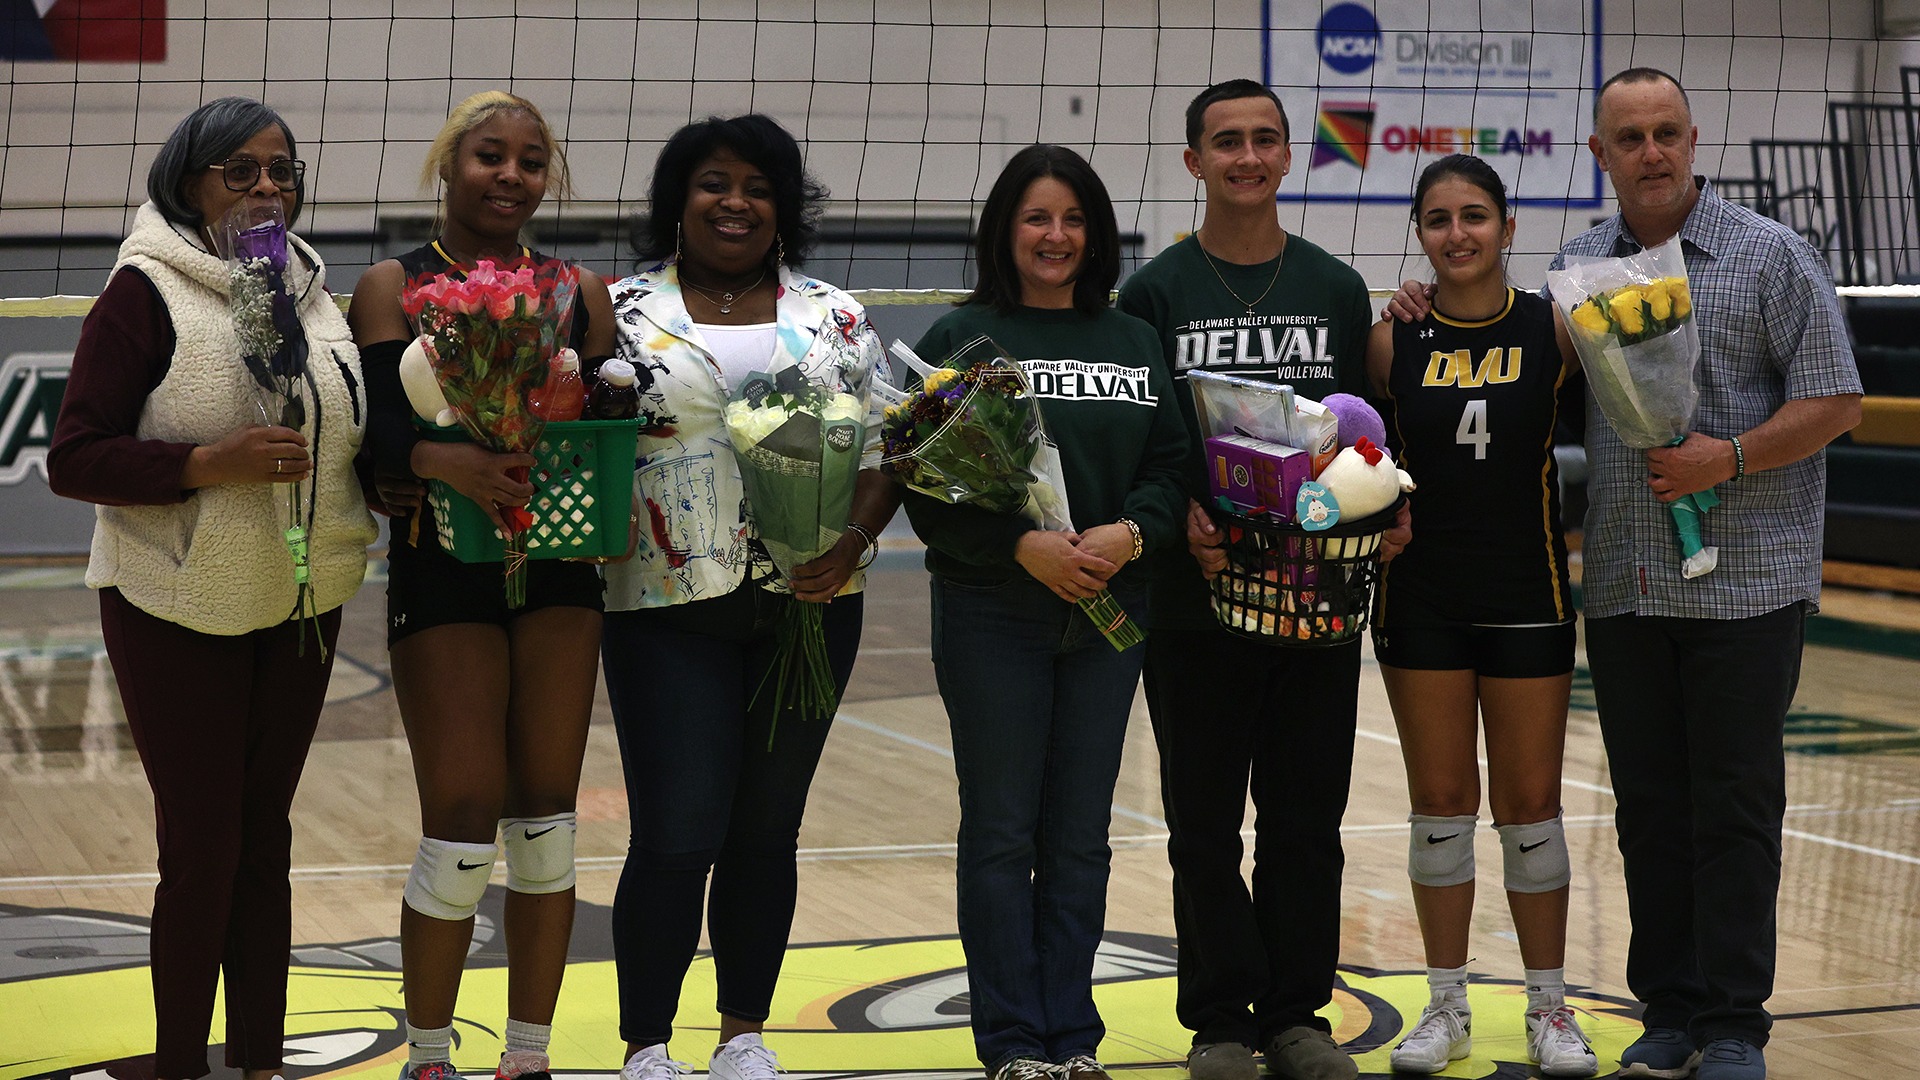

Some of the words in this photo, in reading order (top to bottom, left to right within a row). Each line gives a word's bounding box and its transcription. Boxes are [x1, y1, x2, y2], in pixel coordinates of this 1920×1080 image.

[1321, 36, 1381, 57] NCAA
[1396, 33, 1503, 64] Division
[1189, 318, 1234, 330] DELAWARE
[1237, 315, 1267, 327] VALLEY
[1270, 315, 1318, 326] UNIVERSITY
[1174, 327, 1335, 370] DELVAL
[1022, 361, 1061, 372] ELAWARE
[1064, 362, 1094, 374] VALLEY
[1097, 365, 1148, 378] UNIVERSITY
[1421, 346, 1523, 389] DVU
[1032, 372, 1159, 403] DELVAL
[1455, 399, 1491, 460] 4
